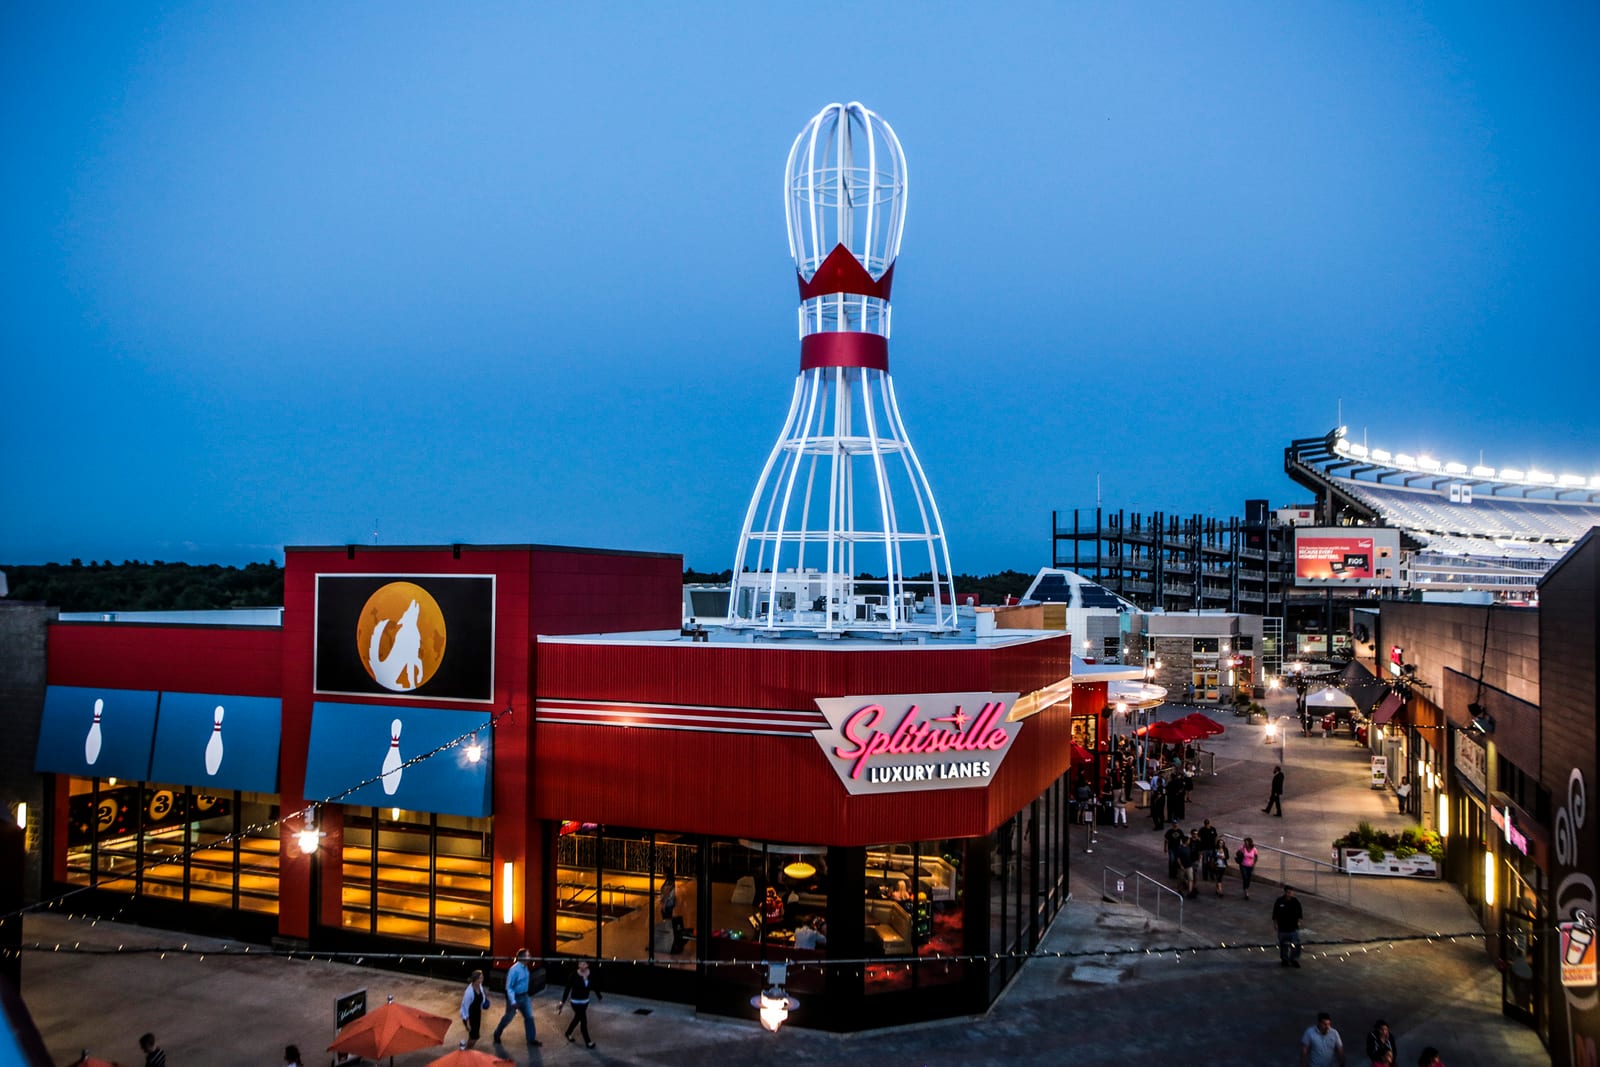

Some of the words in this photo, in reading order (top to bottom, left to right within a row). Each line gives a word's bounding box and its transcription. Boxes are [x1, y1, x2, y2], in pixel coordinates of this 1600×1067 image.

[834, 702, 1009, 780] Splitsville
[871, 765, 935, 784] LUXURY
[940, 762, 990, 779] LANES
[154, 795, 170, 813] 3
[98, 806, 113, 825] 2
